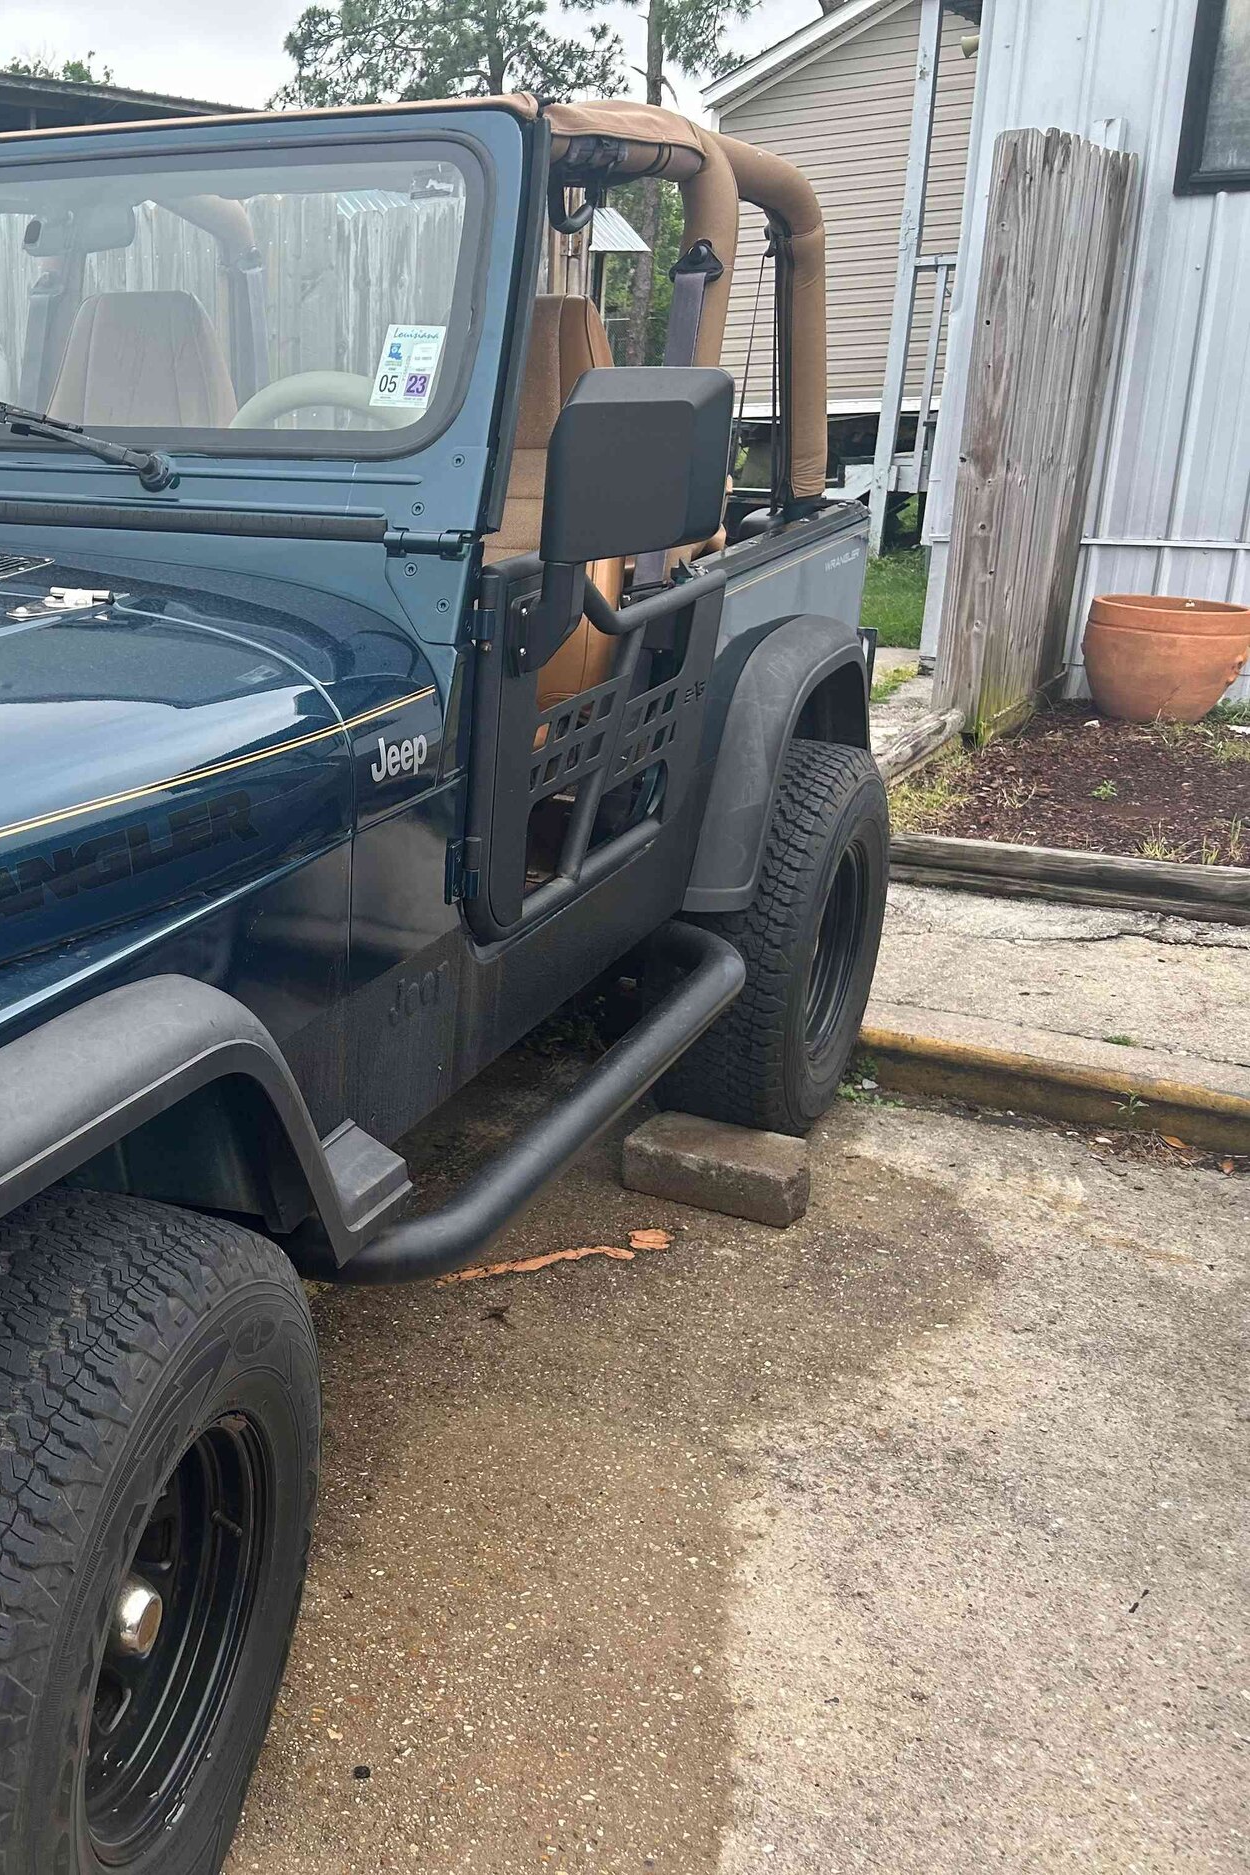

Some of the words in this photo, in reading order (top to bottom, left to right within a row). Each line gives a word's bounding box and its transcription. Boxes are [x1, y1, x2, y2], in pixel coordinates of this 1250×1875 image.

[393, 327, 440, 340] Louisiana
[378, 374, 399, 393] 05
[406, 375, 428, 394] 23
[824, 548, 860, 573] WRANGLER
[371, 734, 428, 782] Jeep
